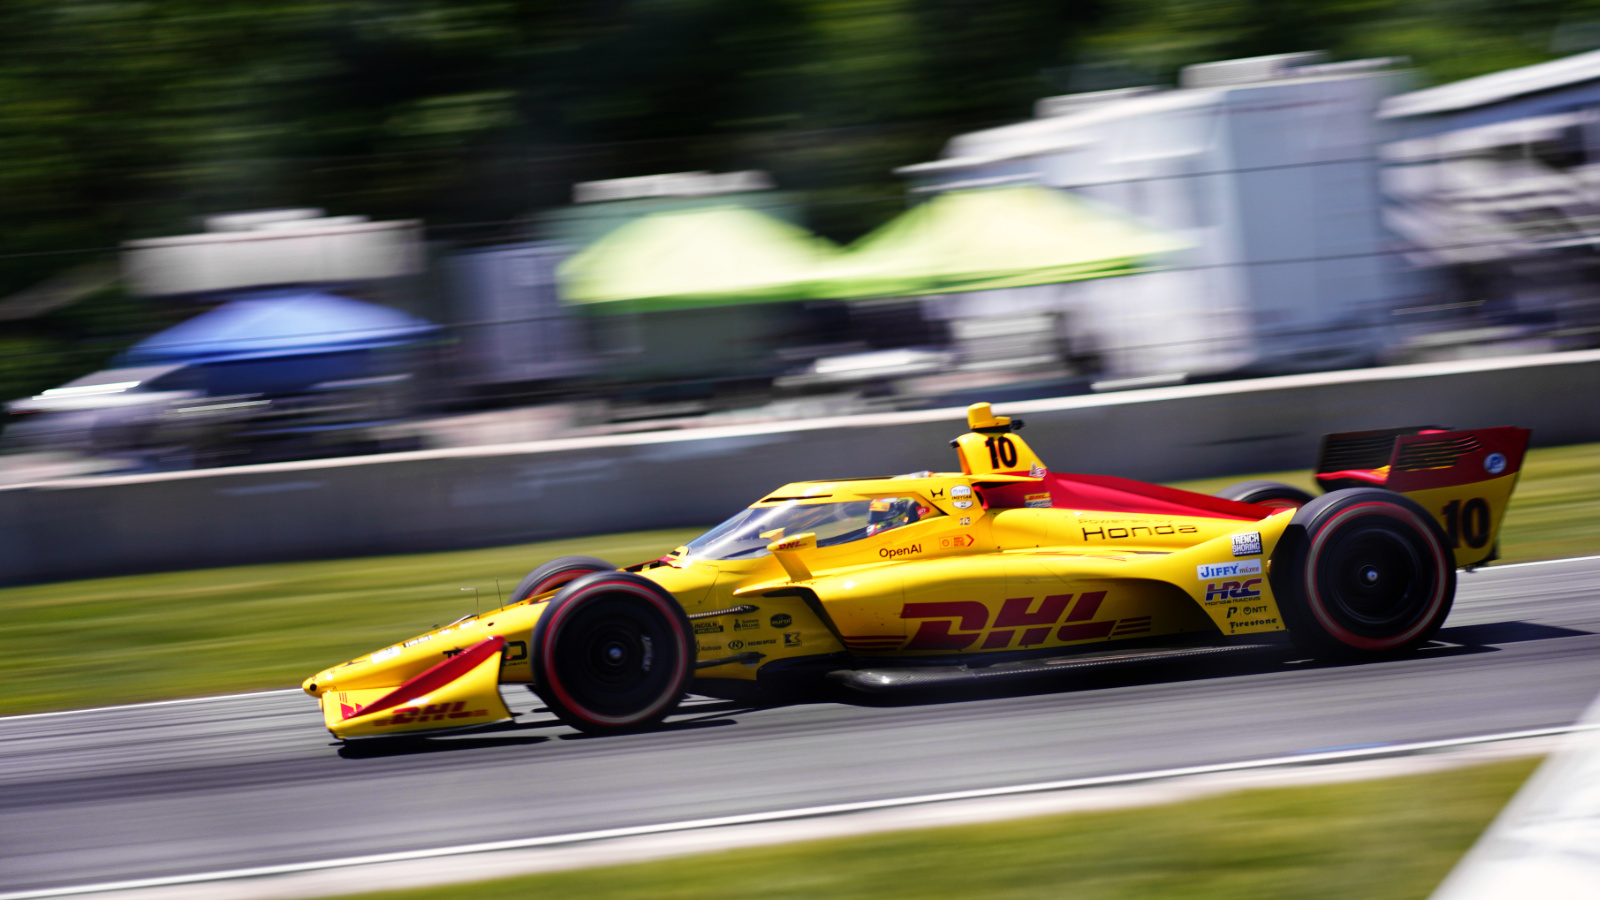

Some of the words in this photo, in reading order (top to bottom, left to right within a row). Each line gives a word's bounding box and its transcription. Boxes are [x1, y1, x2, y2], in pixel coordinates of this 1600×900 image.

[985, 436, 1017, 470] 10
[1441, 497, 1491, 549] 10
[778, 541, 801, 550] DHL
[1232, 533, 1259, 545] TRENCH
[879, 544, 922, 559] OpenAI
[1233, 542, 1261, 553] SHORING
[1201, 565, 1238, 578] JIFFY
[1239, 566, 1260, 574] mixes
[1206, 579, 1262, 601] HRC
[772, 618, 791, 626] eurol
[900, 590, 1118, 650] DHL
[1230, 618, 1277, 629] Firestone
[391, 701, 473, 725] DHL
